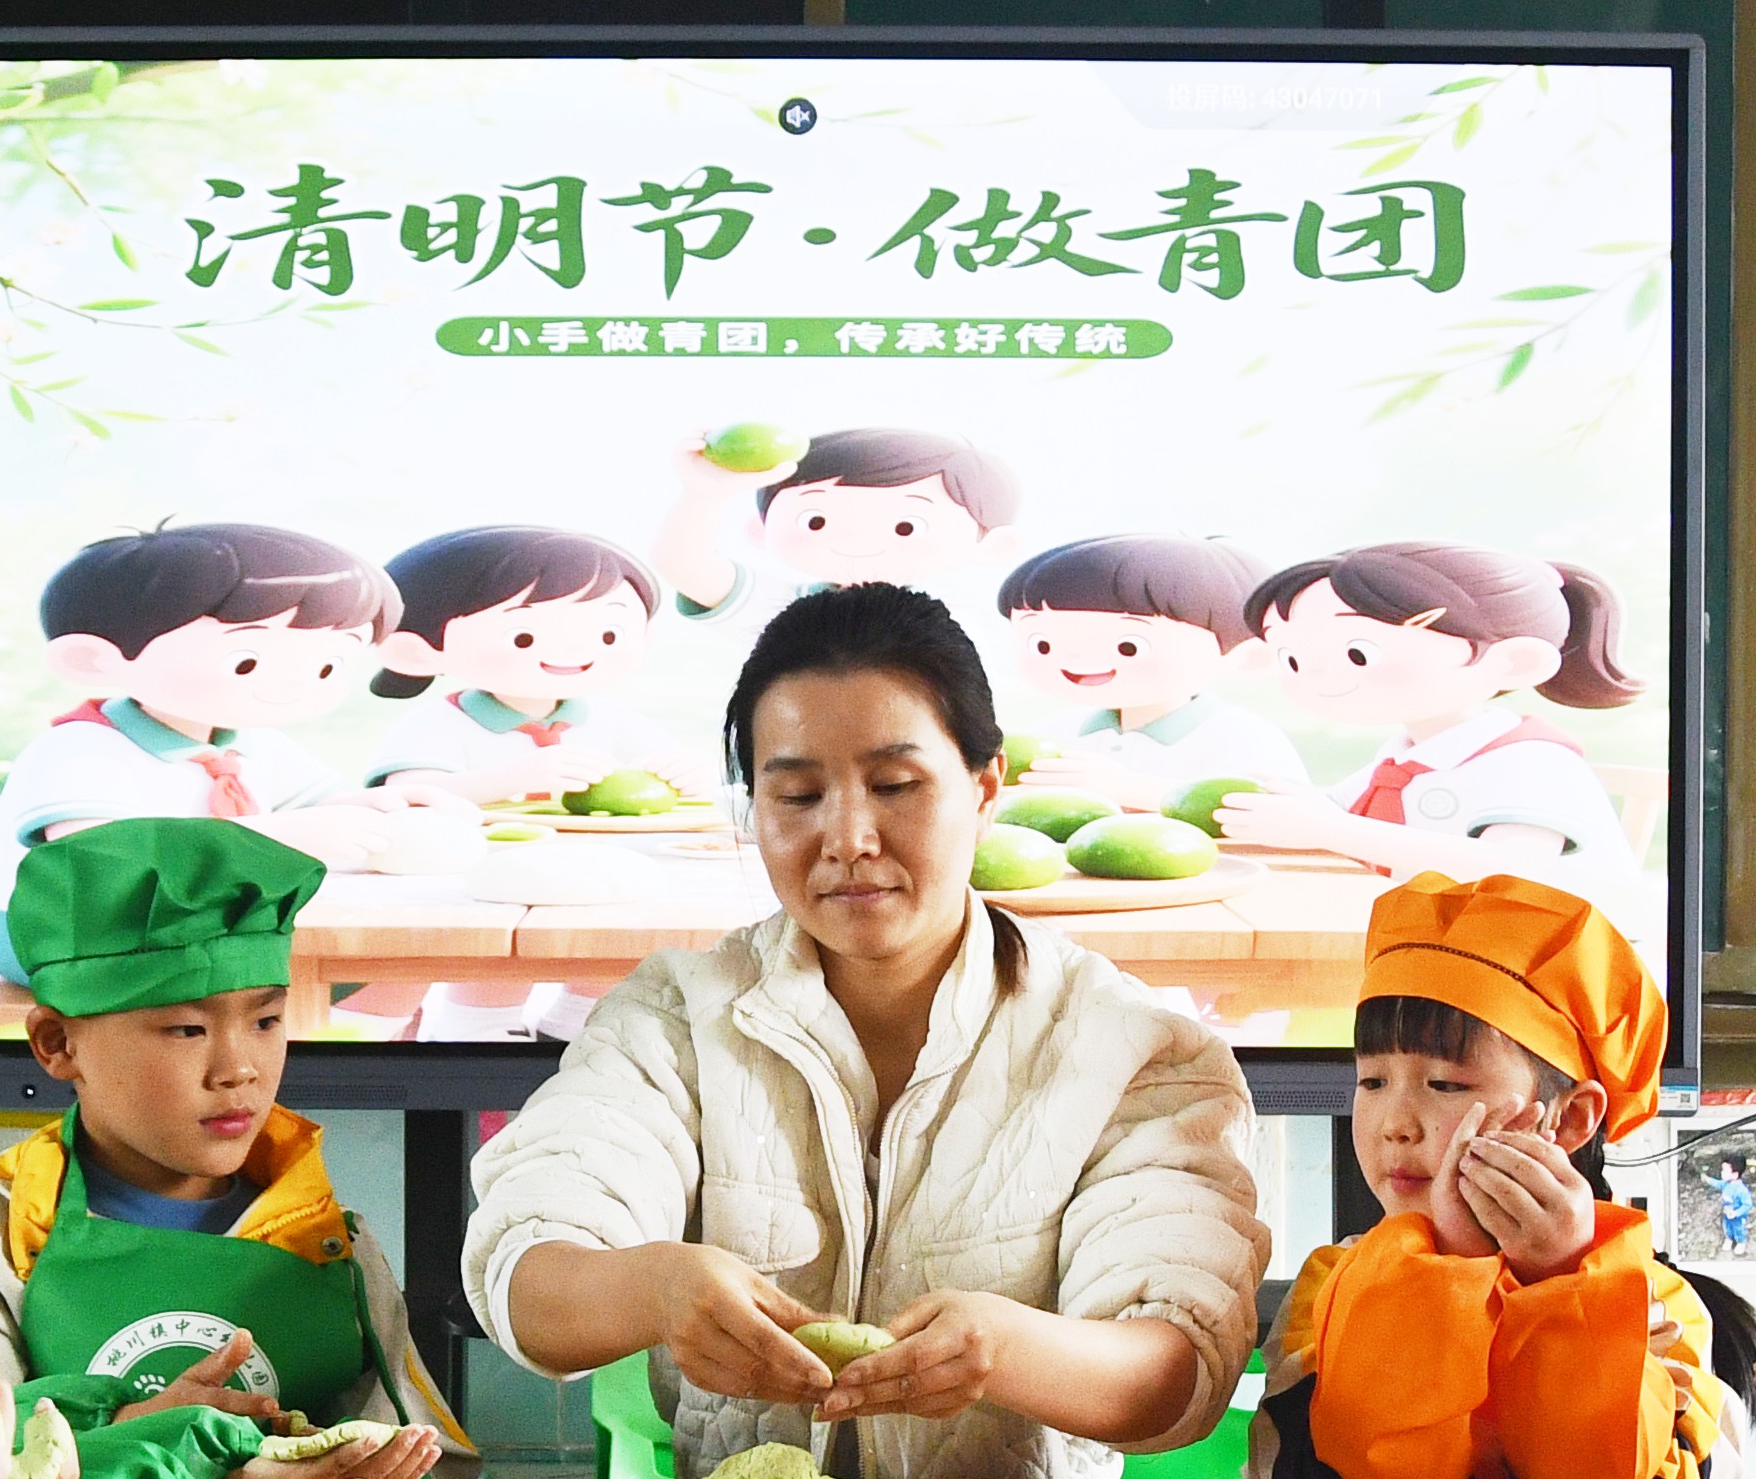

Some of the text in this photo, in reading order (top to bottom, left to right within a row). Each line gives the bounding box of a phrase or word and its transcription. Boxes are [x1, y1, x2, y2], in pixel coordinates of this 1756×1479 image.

[1262, 85, 1382, 111] 43047071
[184, 163, 1466, 301] 清明节·做青团
[476, 320, 1129, 355] 小手做青团，传承好传统
